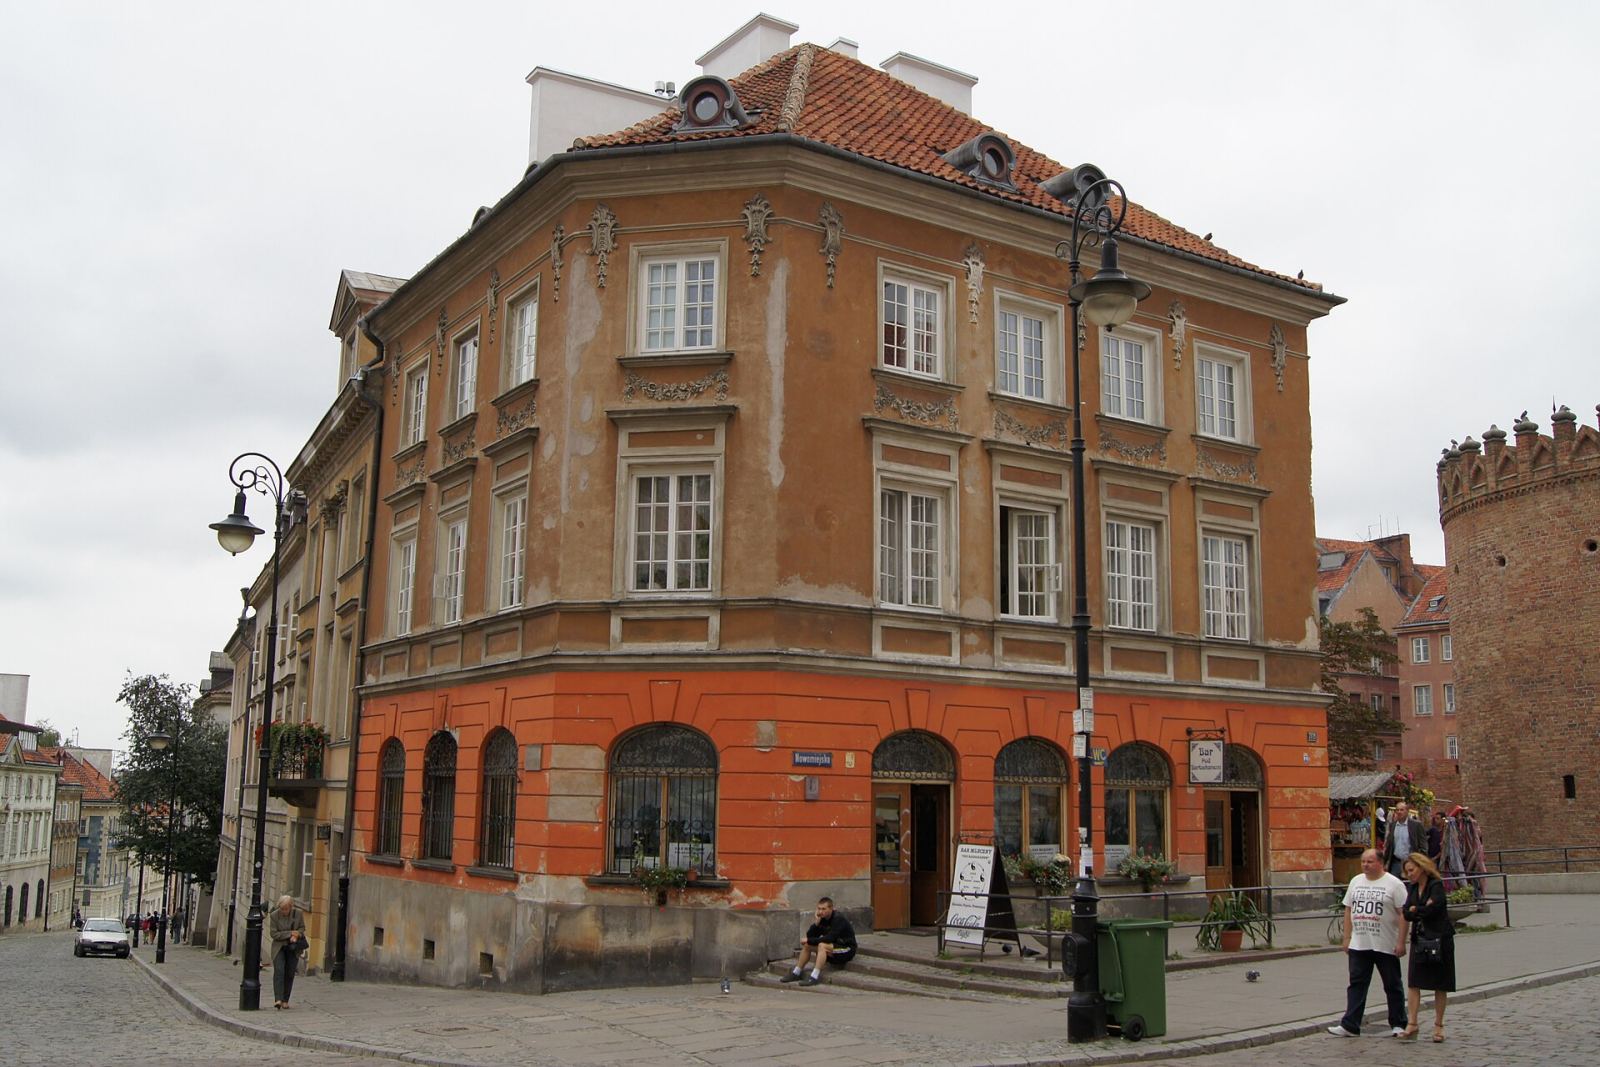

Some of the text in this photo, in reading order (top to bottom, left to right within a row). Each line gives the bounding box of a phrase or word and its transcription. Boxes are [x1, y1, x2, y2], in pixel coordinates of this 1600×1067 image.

[1093, 748, 1106, 761] WC
[1199, 748, 1213, 756] Bar
[795, 753, 831, 766] Nowomiejska
